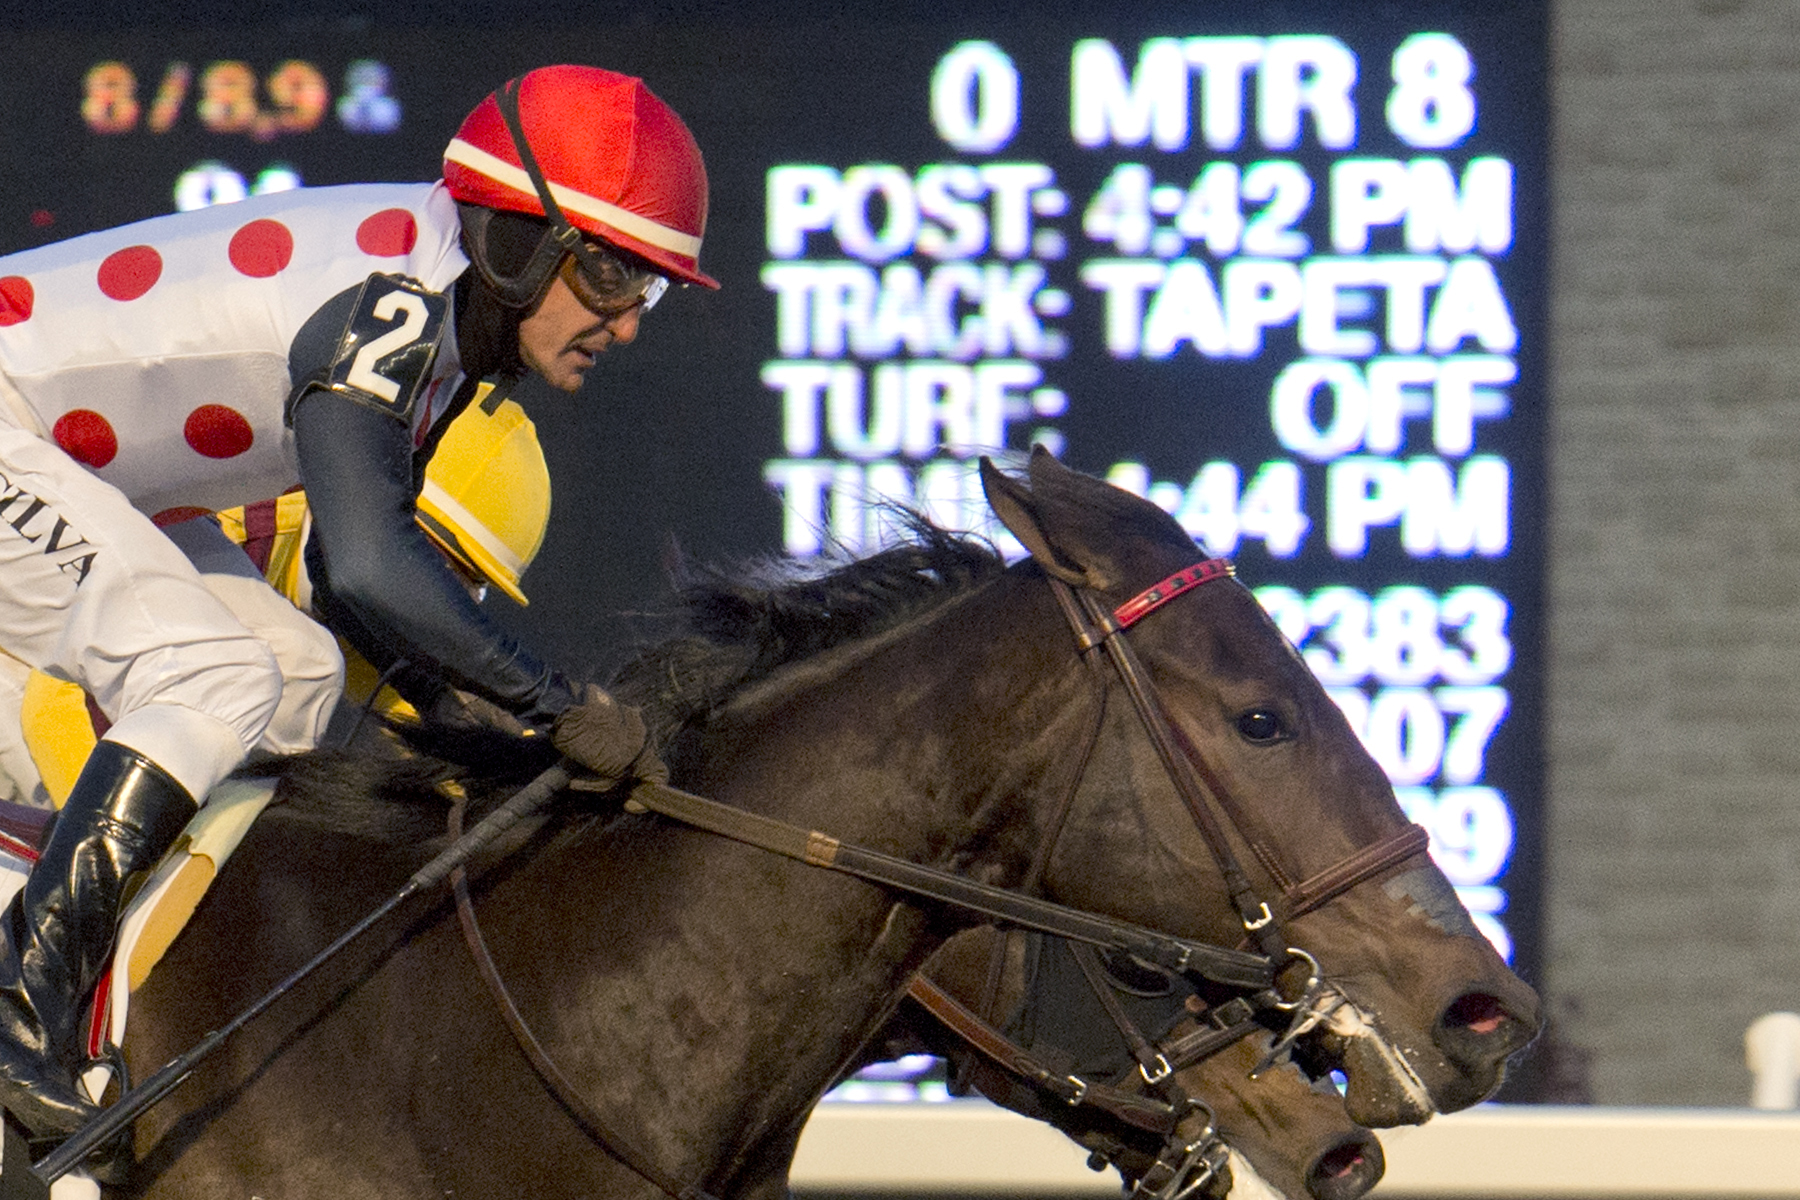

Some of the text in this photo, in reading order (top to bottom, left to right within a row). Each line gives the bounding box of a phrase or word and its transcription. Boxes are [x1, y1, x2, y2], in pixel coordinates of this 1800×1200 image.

[1070, 35, 1359, 151] MTR
[1386, 32, 1477, 148] 8
[765, 156, 1515, 261] POST: 4:42 PM
[345, 289, 429, 403] 2
[760, 255, 1518, 360] TRACK: TAPETA
[760, 356, 1518, 460] TURF: OFF
[1105, 460, 1313, 560] :44
[1326, 456, 1513, 558] PM
